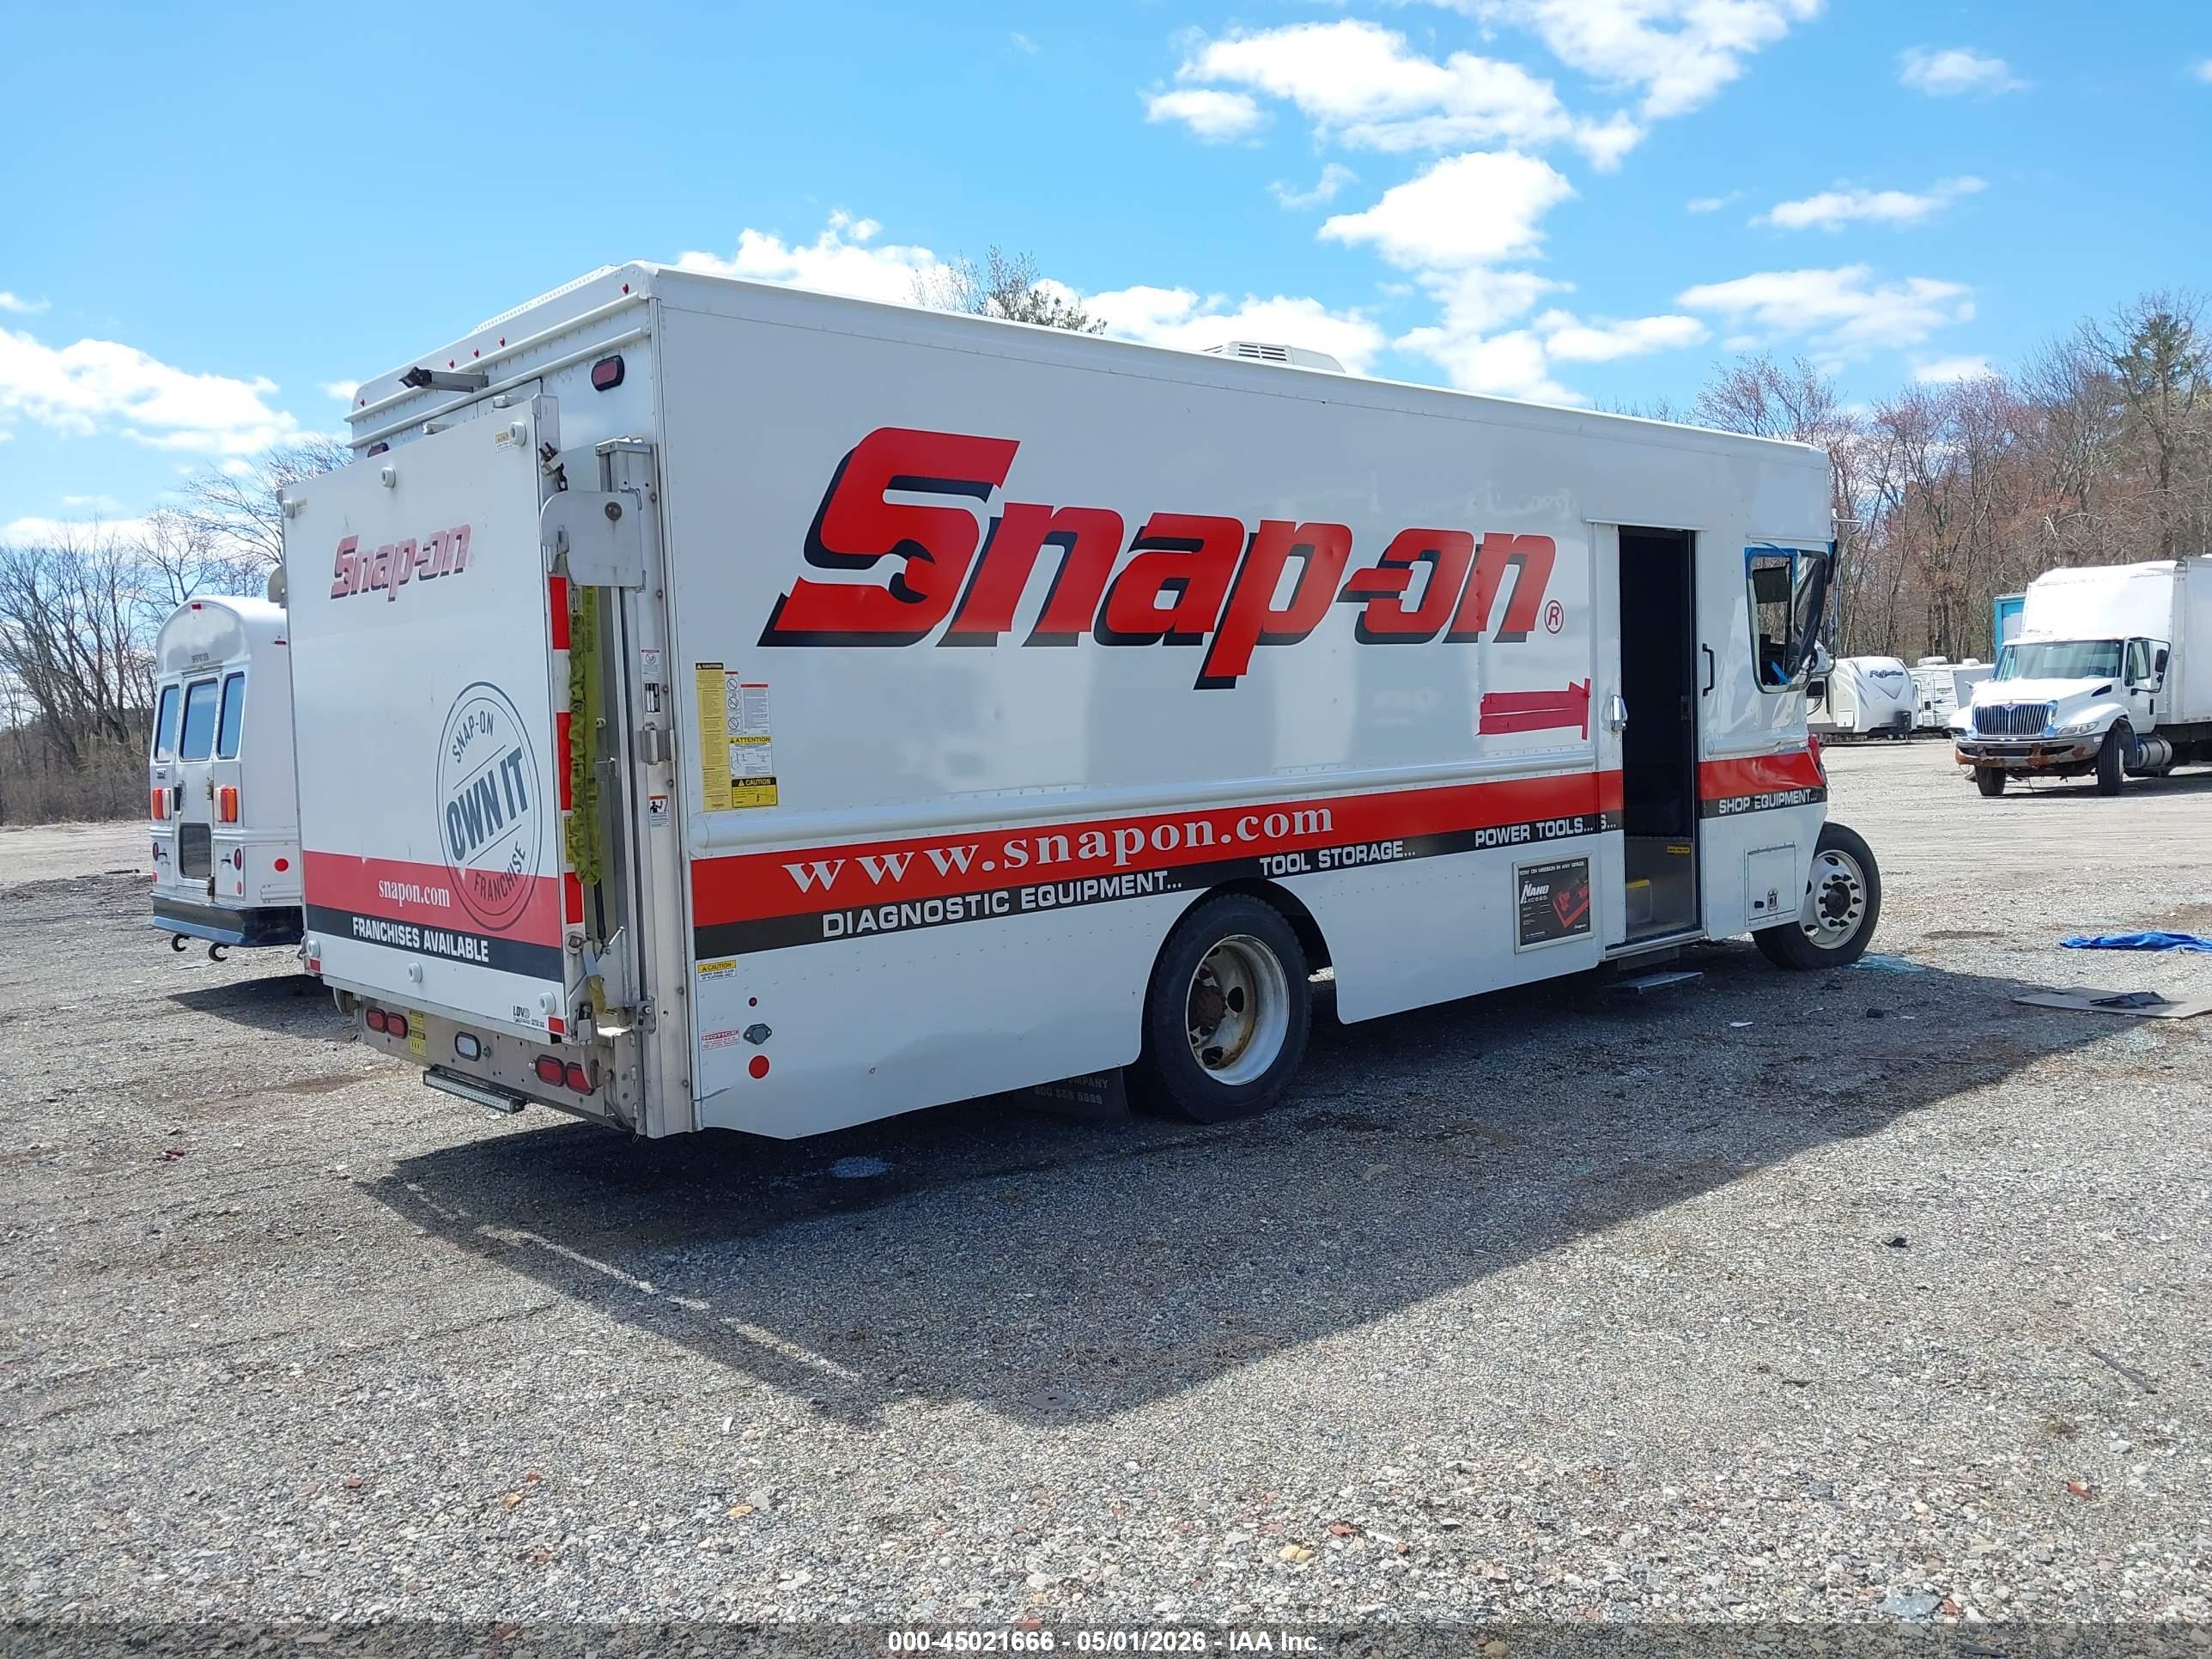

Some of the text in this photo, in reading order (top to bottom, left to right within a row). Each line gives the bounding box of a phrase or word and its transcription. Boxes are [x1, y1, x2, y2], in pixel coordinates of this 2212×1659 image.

[330, 523, 472, 603] Snap-on
[757, 426, 1557, 690] Snap-on
[452, 709, 495, 764] SNAP-ON
[445, 769, 503, 861] OWN
[500, 746, 529, 821] IT
[1718, 788, 1817, 814] SHOP EQUIPMENT...
[1475, 817, 1594, 848] POWER TOOLS...
[474, 840, 526, 902] FRANCHISE
[1259, 841, 1416, 877] TOOL STORAGE...
[379, 879, 450, 908] snapon.com
[822, 870, 1182, 938] DIAGNOSTIC EQUIPMENT...
[1522, 883, 1549, 898] NANO
[352, 916, 489, 963] FRANCHISES AVAILABLE
[708, 962, 732, 970] CAUTION
[702, 1030, 738, 1040] NOTICE
